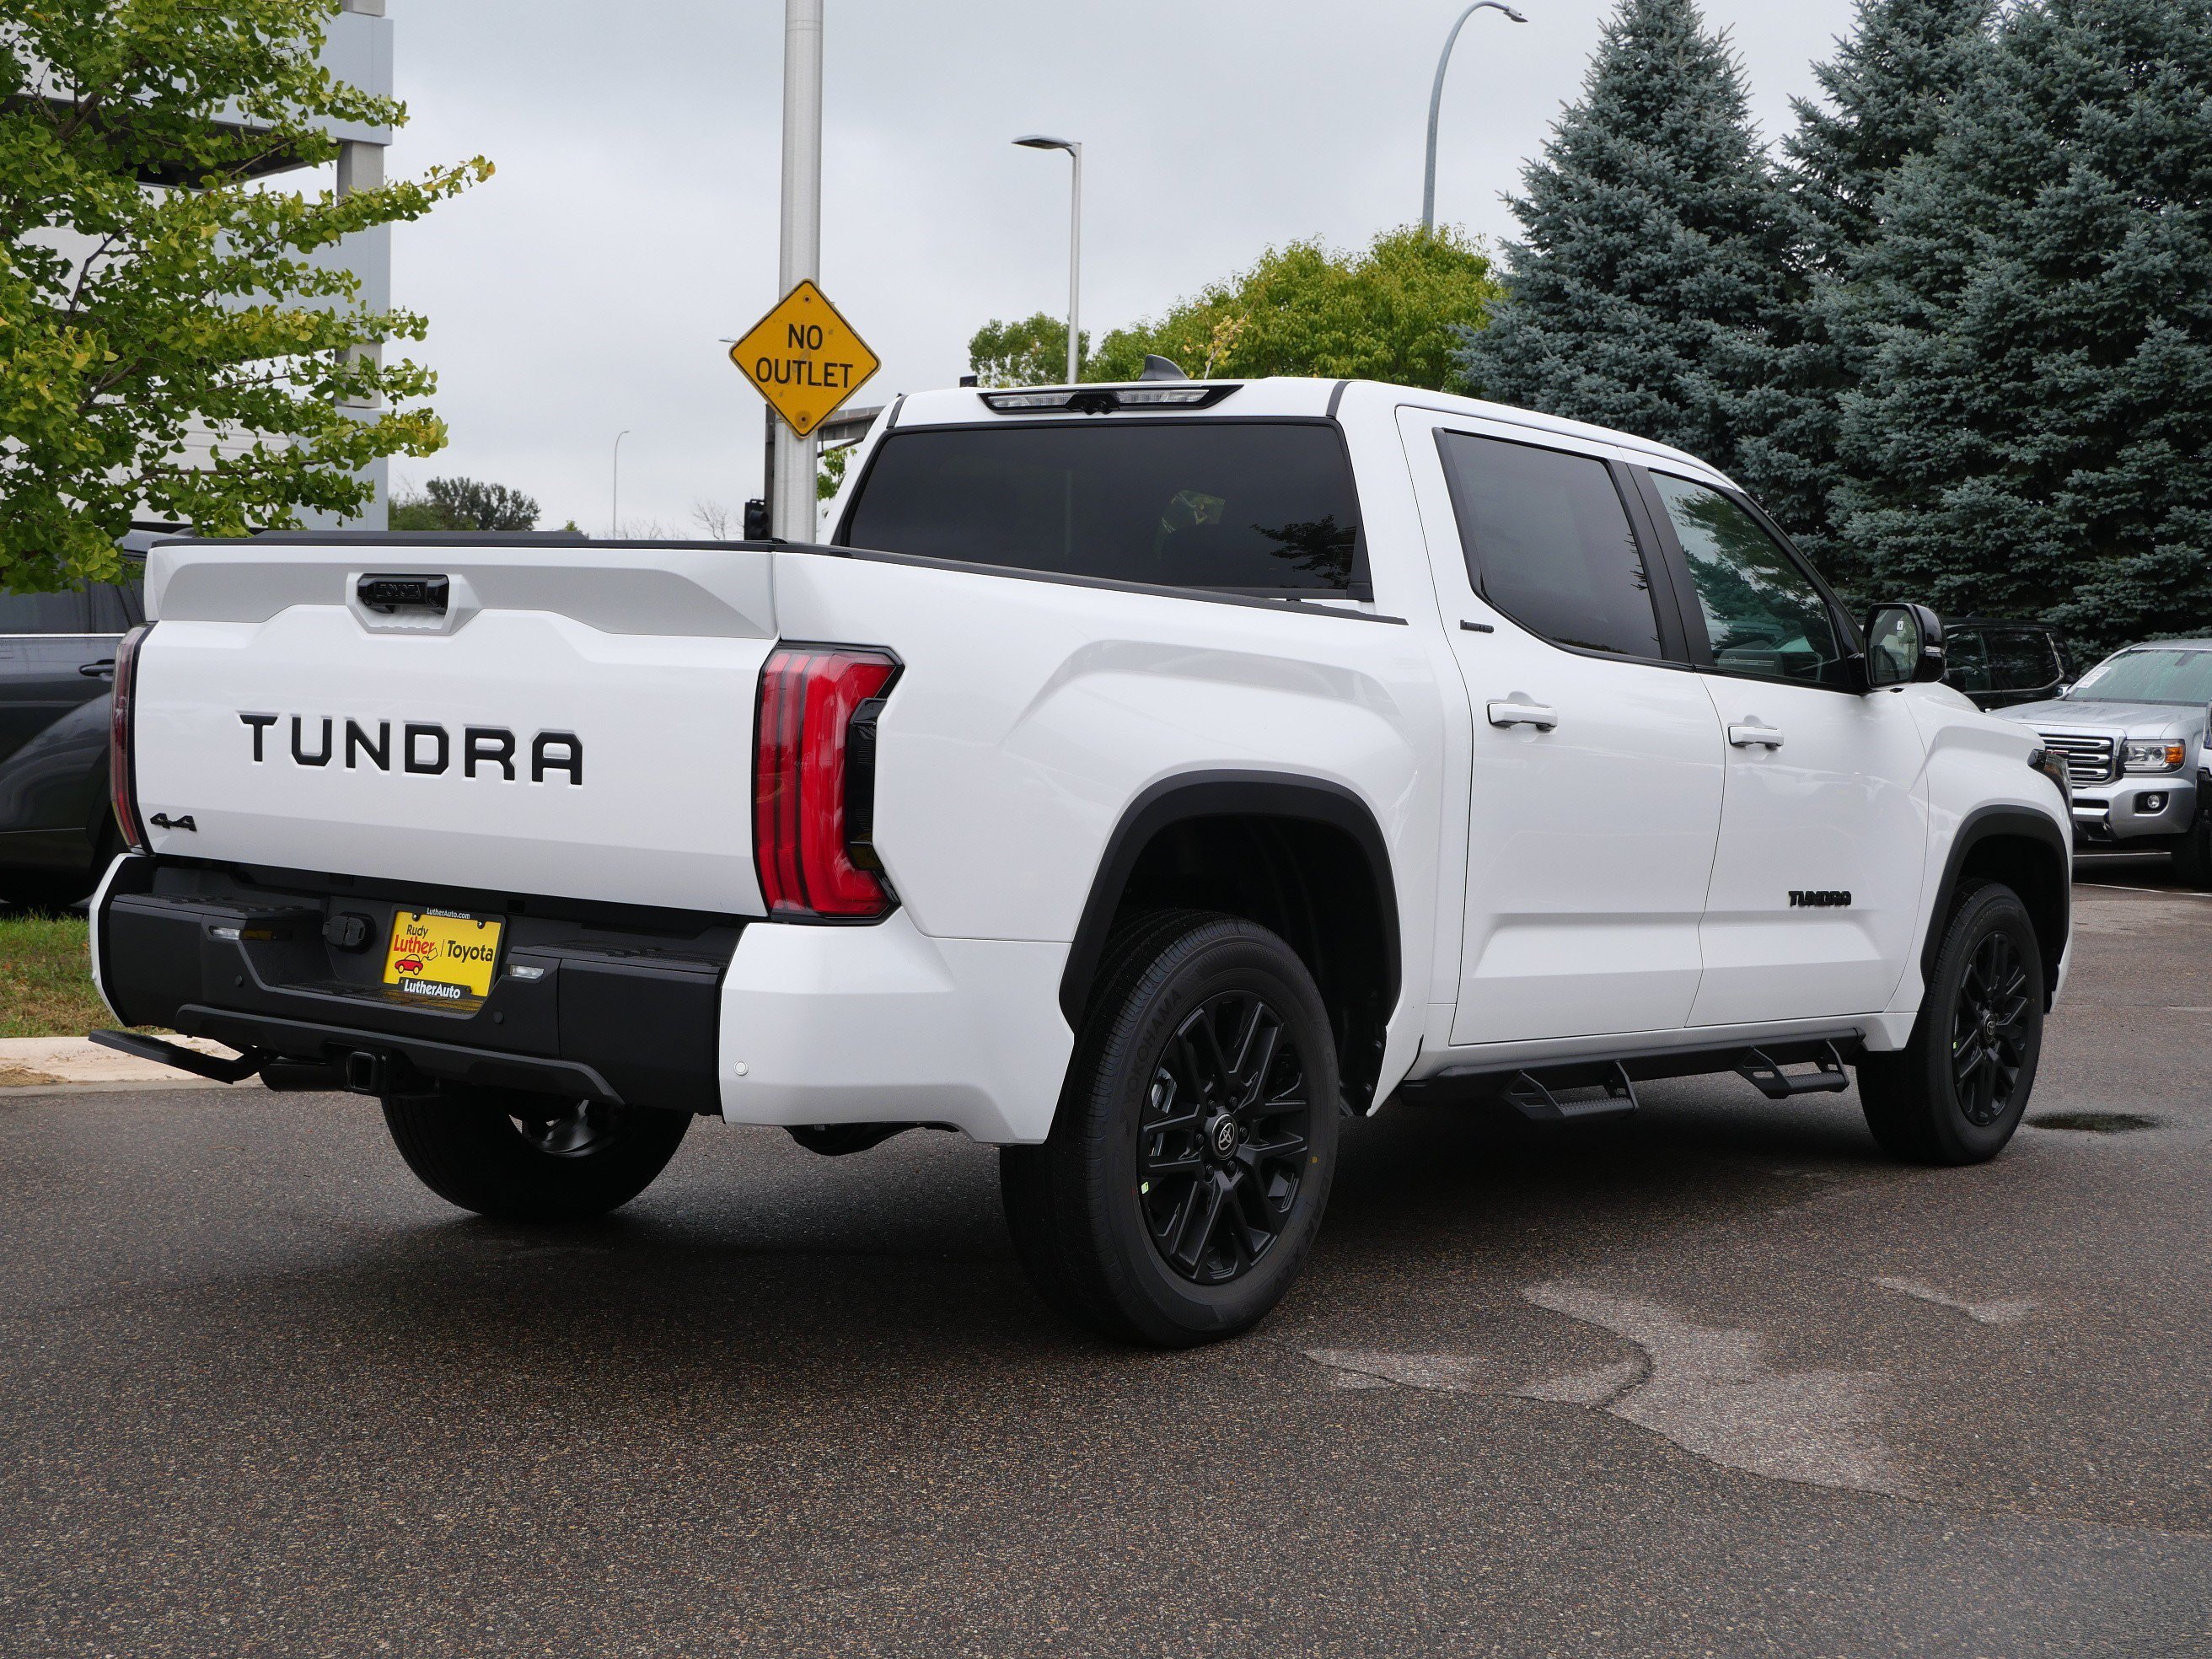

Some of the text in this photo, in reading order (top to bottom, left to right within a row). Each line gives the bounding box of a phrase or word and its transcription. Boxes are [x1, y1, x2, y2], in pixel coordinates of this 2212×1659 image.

[787, 323, 824, 351] NO
[755, 357, 853, 389] OUTLET
[238, 713, 583, 786] TUNDRA
[1788, 890, 1852, 907] TUNDRA
[426, 907, 470, 920] LutherAuto.com
[406, 924, 428, 939] Rudy
[393, 934, 494, 964] Luther Toyota
[404, 979, 461, 999] LutherAuto
[1122, 988, 1182, 1105] YOKOHAMA
